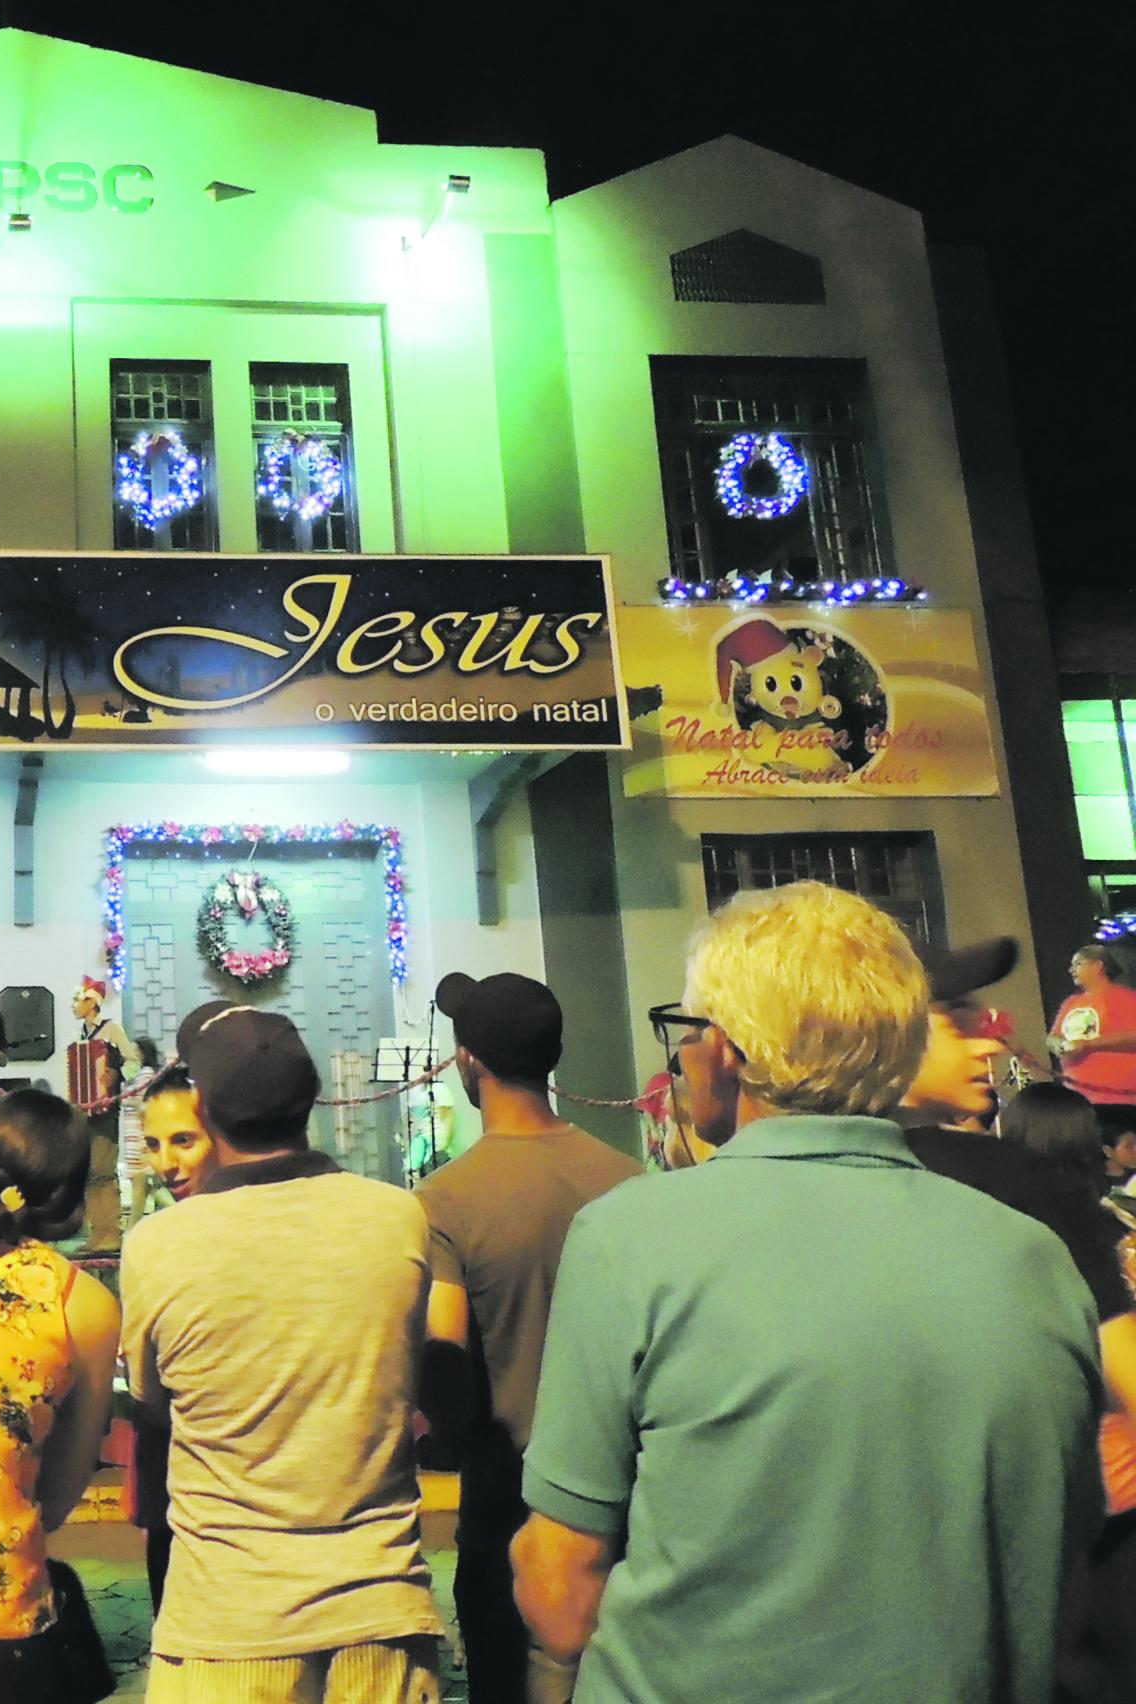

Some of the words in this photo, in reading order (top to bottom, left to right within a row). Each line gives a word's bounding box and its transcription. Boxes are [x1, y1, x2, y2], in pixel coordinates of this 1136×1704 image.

[113, 574, 603, 710] Jesus
[315, 703, 335, 722] o
[349, 697, 518, 722] verdadeiro
[533, 697, 609, 722] natal
[665, 716, 763, 752] Natal
[775, 726, 853, 757] para
[865, 720, 945, 754] todos
[701, 759, 790, 785] Abrace
[860, 763, 921, 785] ideia
